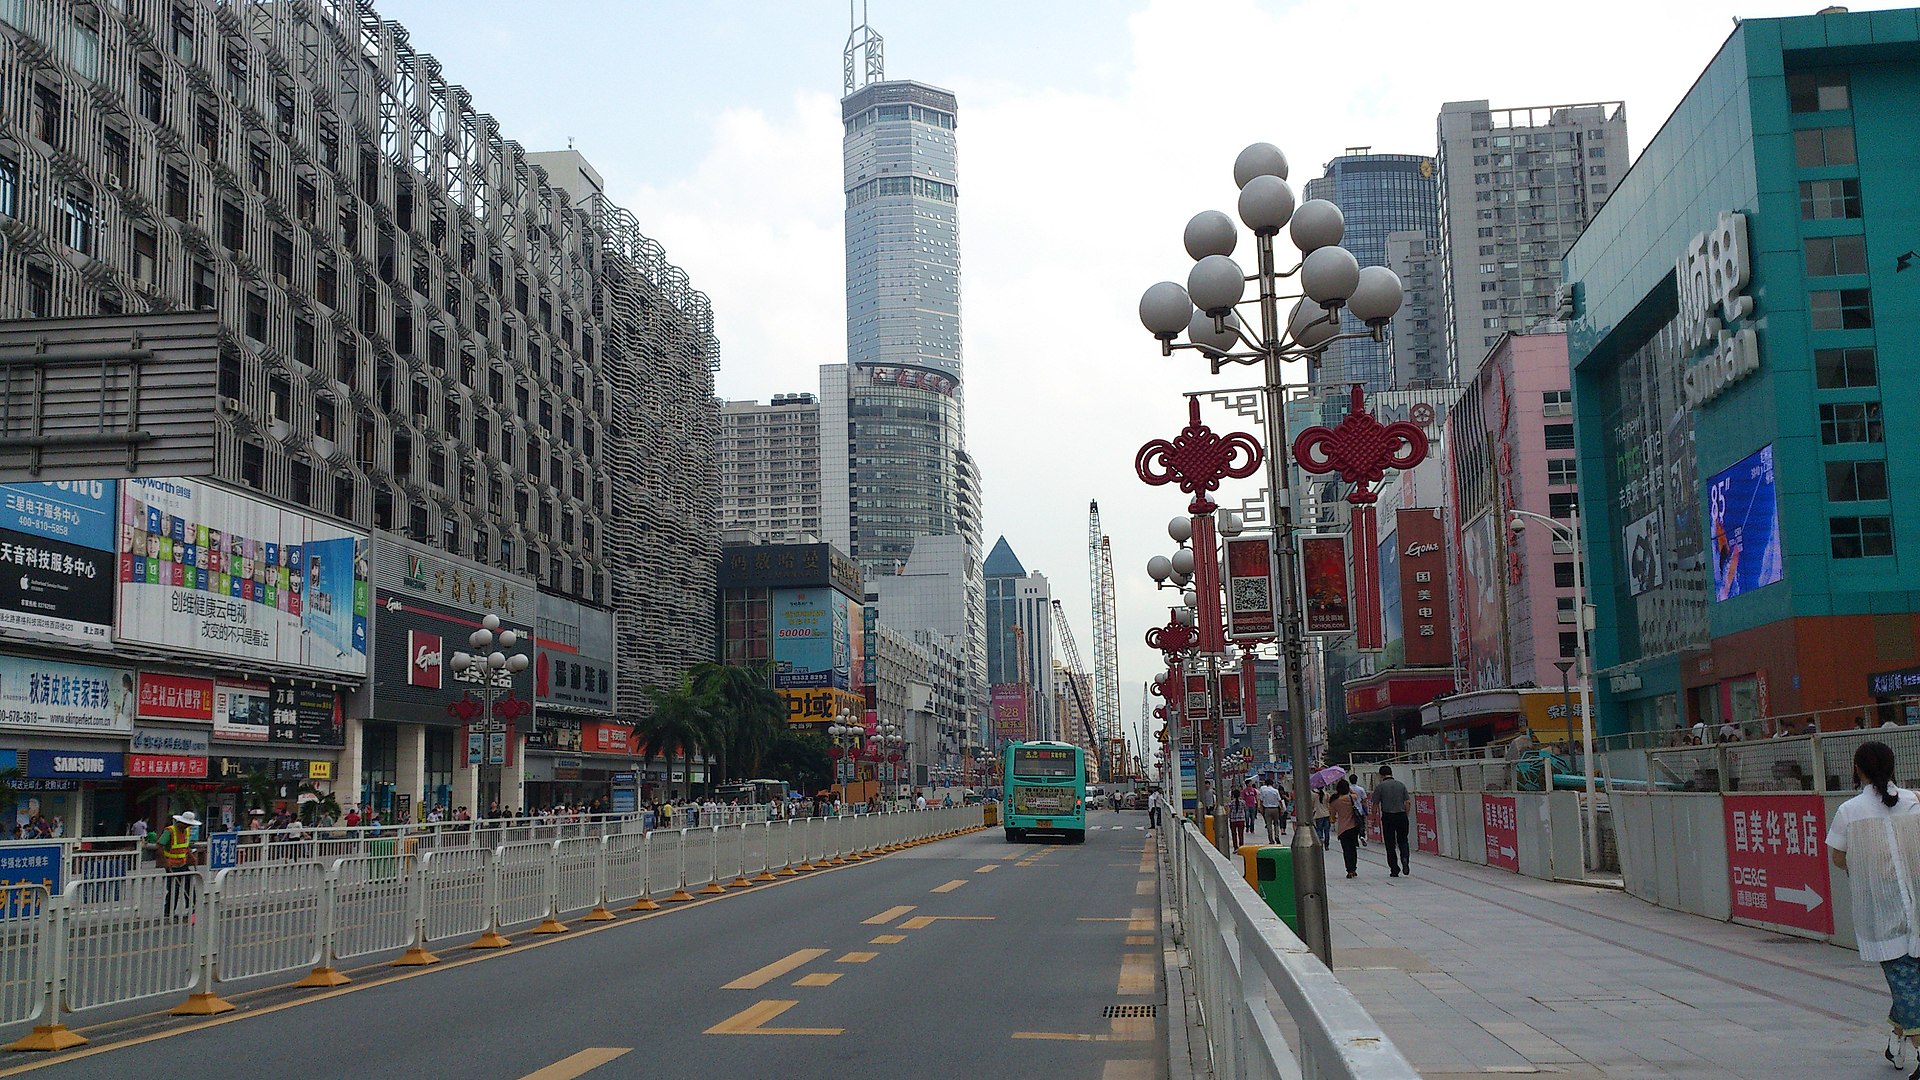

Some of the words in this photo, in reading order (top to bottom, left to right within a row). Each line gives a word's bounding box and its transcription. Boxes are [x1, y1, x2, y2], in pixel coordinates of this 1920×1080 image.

[6, 494, 81, 526] 三星电子服务中心
[18, 515, 69, 536] 400-810-5858
[0, 542, 97, 579] 天音科技服务中心
[171, 590, 248, 625] 创维健康云电视
[1416, 571, 1435, 637] 国美电器
[201, 620, 269, 648] 改变的不只是看法
[778, 628, 812, 638] 50000
[29, 672, 110, 710] 秋涛皮肤专家亲诊
[159, 685, 201, 710] 礼品大世界
[276, 689, 296, 706] 万商
[53, 756, 105, 773] SAMSUNG
[148, 760, 187, 774] 礼品大世界
[1733, 809, 1819, 857] 国美华强店
[212, 838, 236, 865] 下客区
[1733, 866, 1768, 888] DE&E
